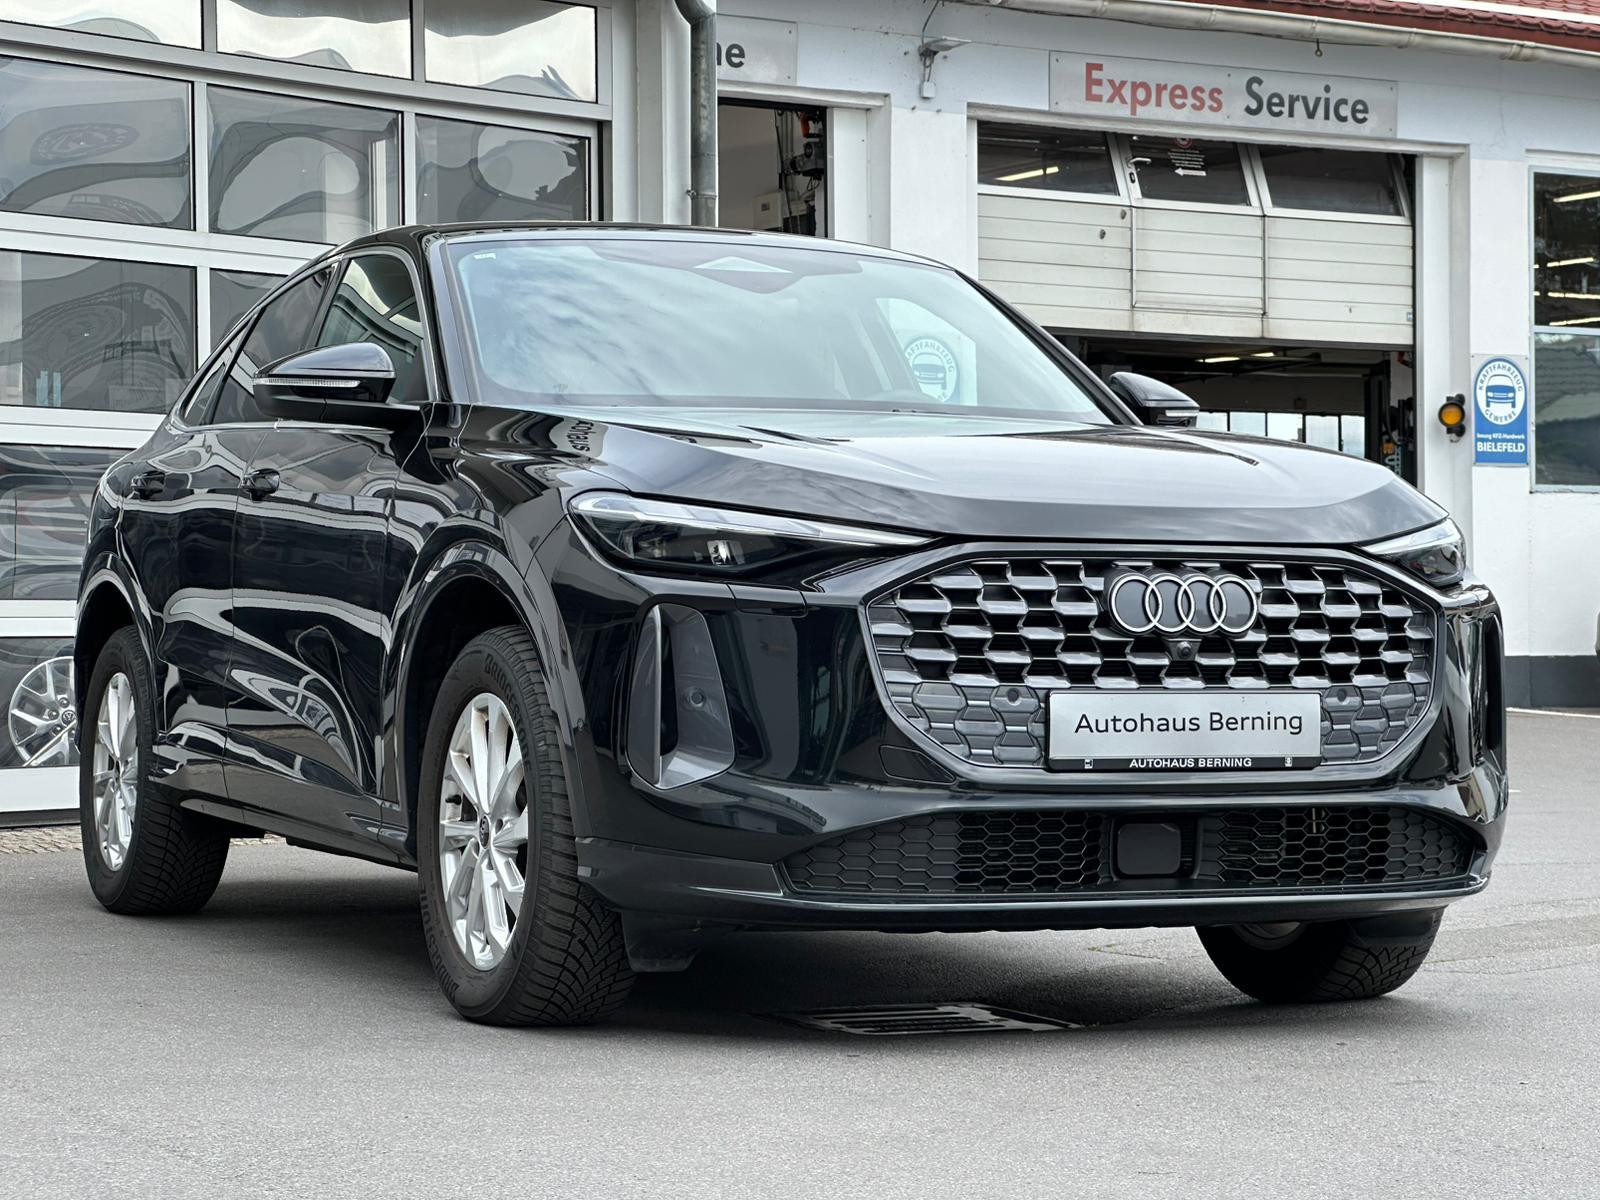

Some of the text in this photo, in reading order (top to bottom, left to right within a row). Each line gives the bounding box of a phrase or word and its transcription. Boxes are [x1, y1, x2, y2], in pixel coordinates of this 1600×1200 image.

[716, 42, 746, 69] e
[1085, 62, 1370, 125] Express Service
[1476, 441, 1526, 453] BIELEFELD
[1074, 711, 1304, 735] Autohaus Berning
[1129, 757, 1253, 769] AUTOHAUS BERNING
